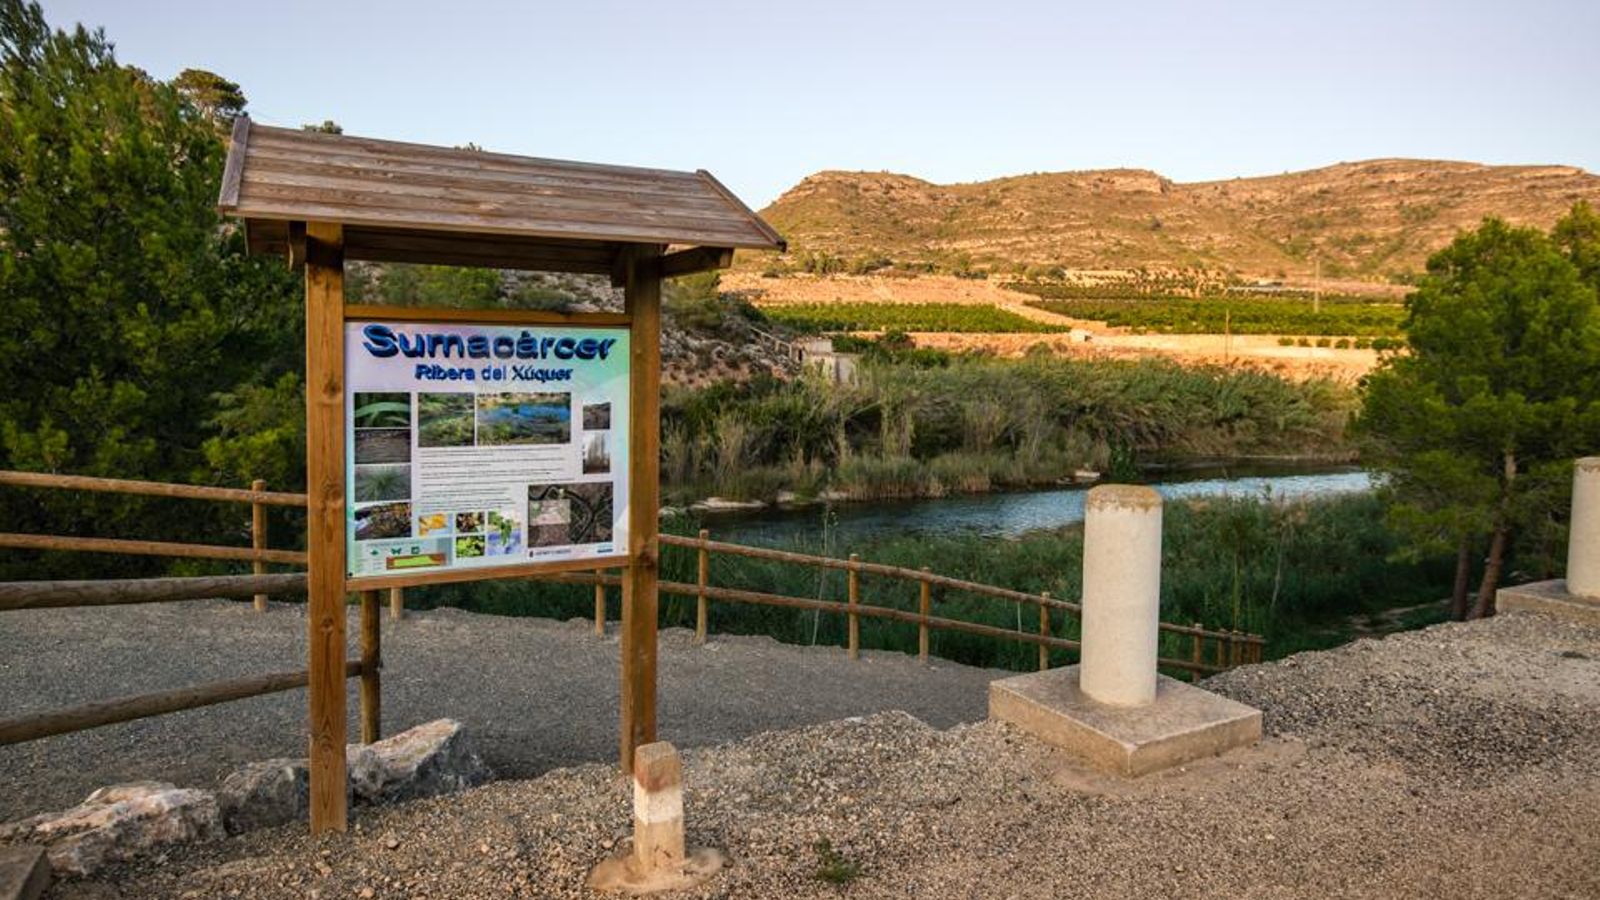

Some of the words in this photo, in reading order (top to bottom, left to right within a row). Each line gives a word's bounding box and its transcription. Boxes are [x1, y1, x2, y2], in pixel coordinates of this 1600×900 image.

[414, 364, 475, 381] Ribera
[481, 365, 507, 381] del
[512, 365, 573, 384] Xúquer
